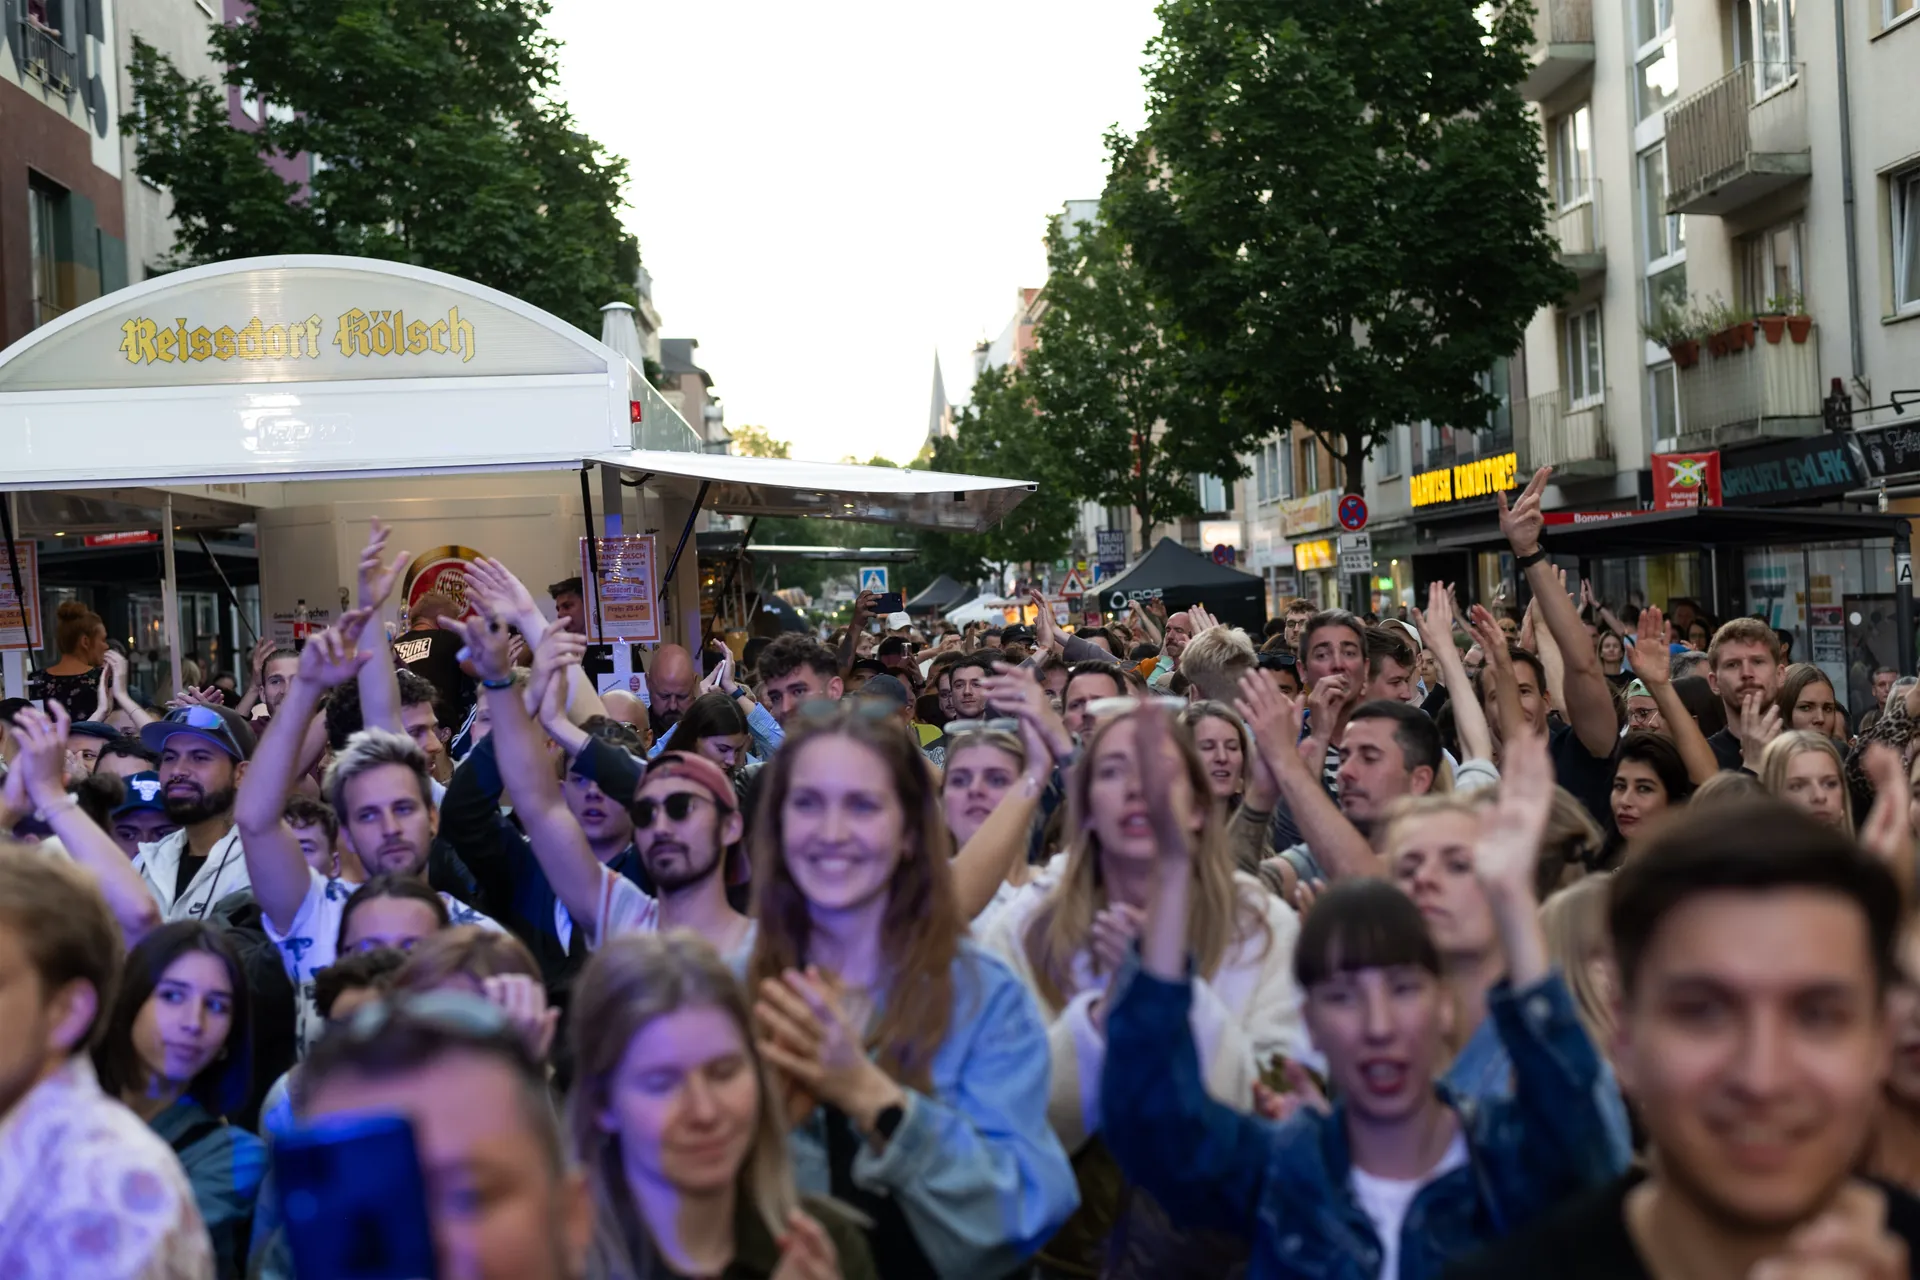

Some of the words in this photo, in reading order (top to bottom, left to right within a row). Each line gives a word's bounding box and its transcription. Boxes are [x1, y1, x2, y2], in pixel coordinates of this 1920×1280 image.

[119, 314, 323, 366] Reissdorf
[332, 305, 475, 364] Kölsch
[1785, 448, 1853, 490] EMLAK
[1574, 513, 1609, 524] Bonner
[1098, 532, 1123, 543] TRAU
[1099, 543, 1124, 555] DICH
[1900, 564, 1912, 582] A
[1128, 588, 1164, 600] IQOS
[394, 639, 429, 660] SURE
